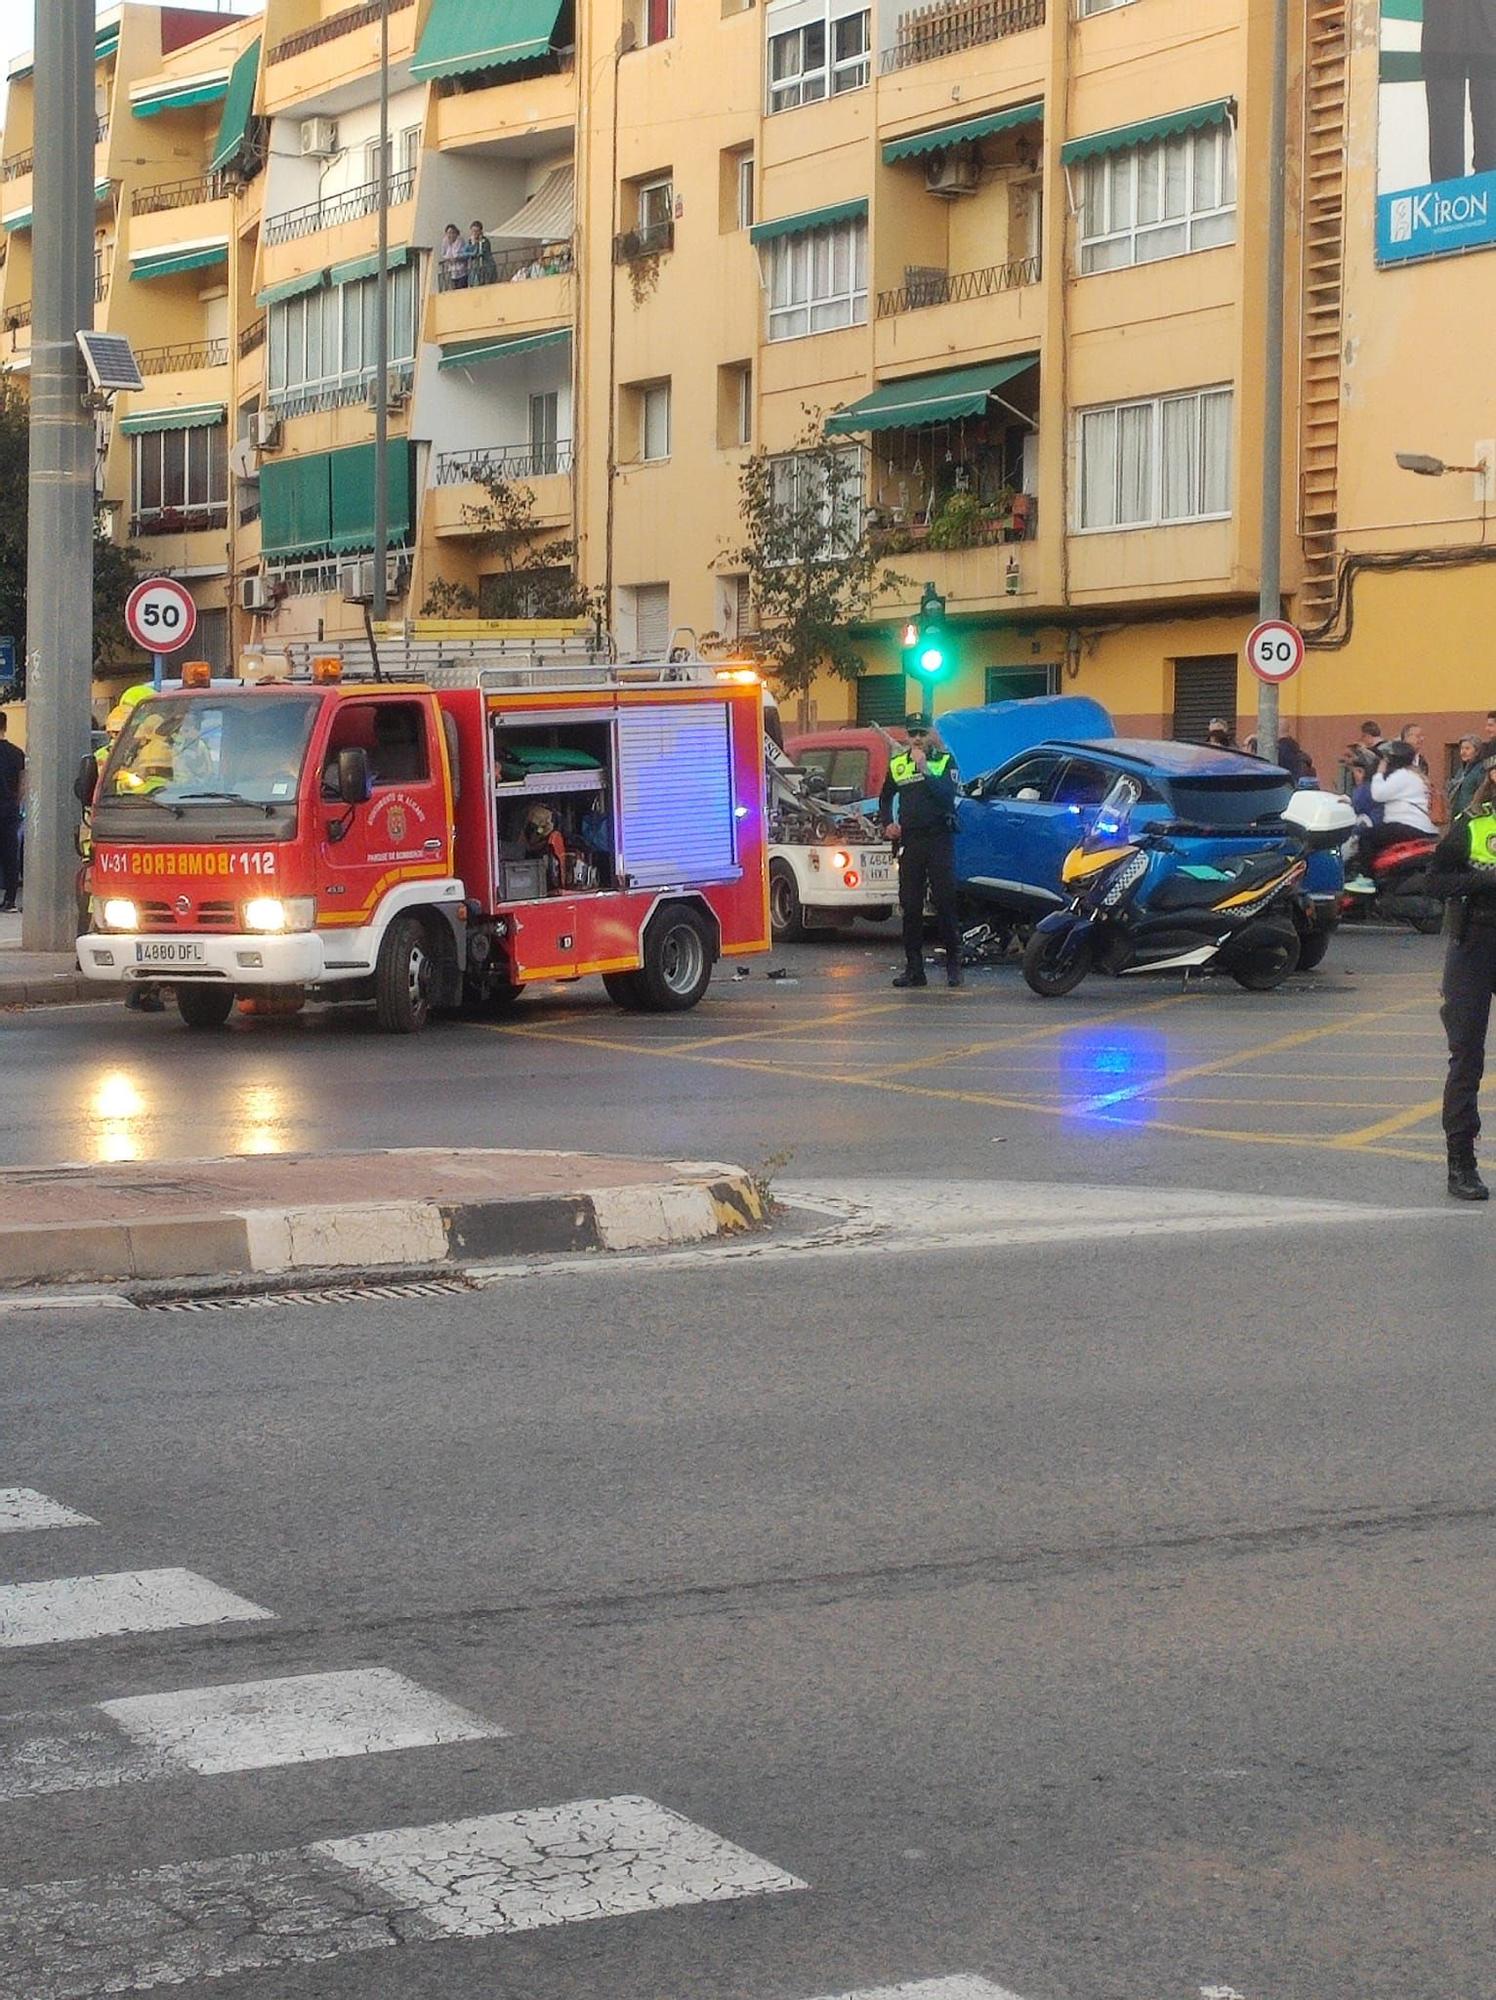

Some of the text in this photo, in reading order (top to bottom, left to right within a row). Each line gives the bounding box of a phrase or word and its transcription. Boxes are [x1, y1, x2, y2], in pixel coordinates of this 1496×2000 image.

[143, 603, 179, 628] 50
[1261, 641, 1291, 661] 50
[101, 853, 127, 873] V-31
[240, 851, 276, 875] 112
[144, 944, 202, 961] 4880 DFL
